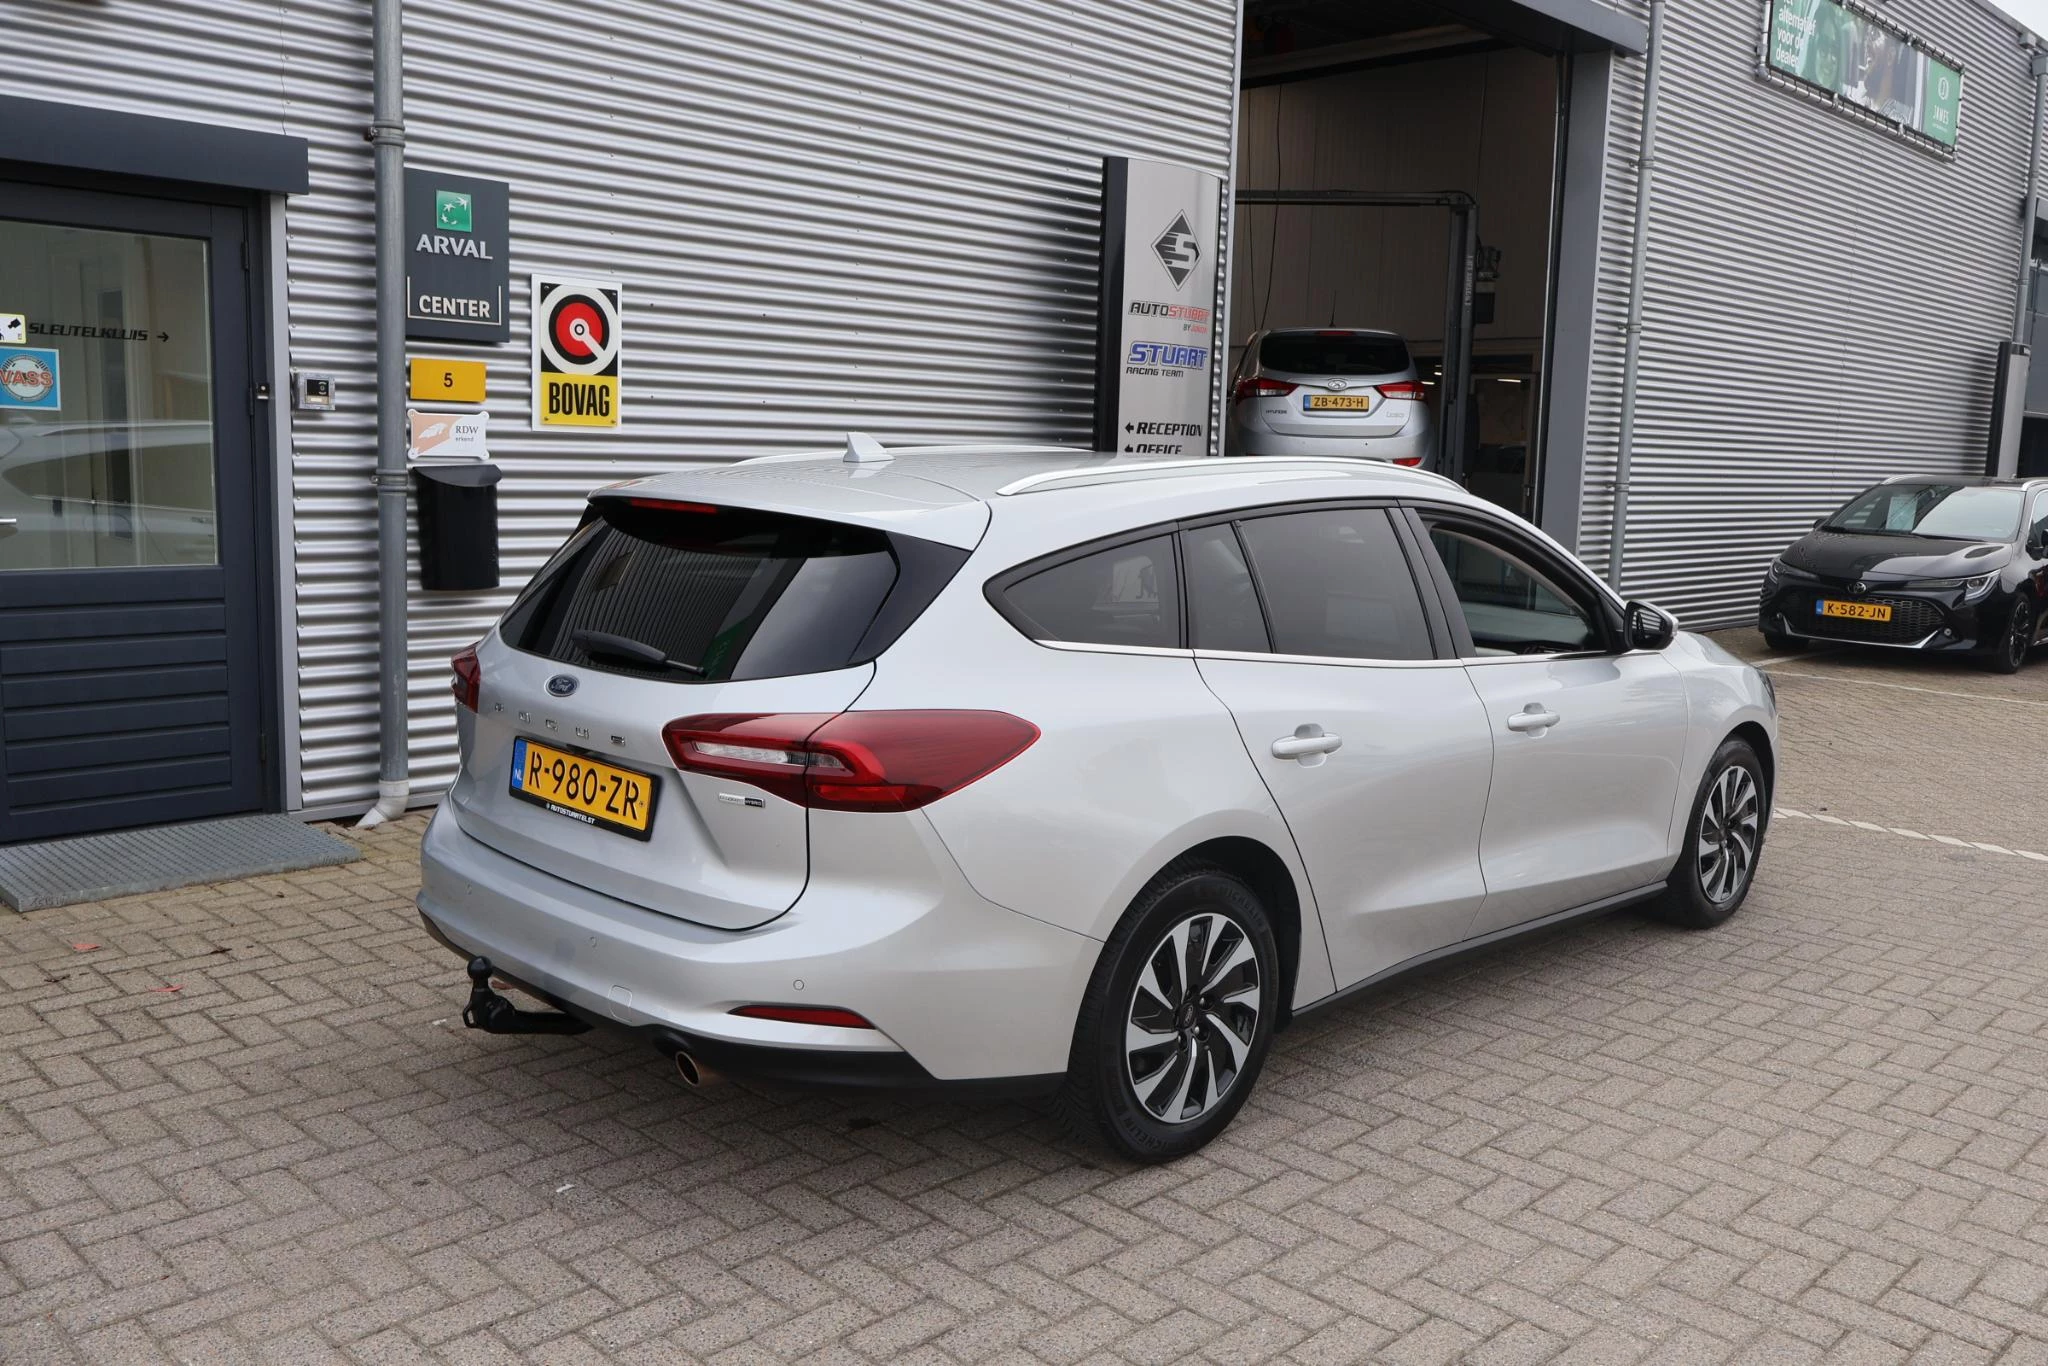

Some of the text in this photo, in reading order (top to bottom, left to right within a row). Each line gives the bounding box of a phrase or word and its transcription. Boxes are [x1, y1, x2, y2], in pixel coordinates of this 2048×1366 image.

[1778, 5, 1817, 37] alternatief
[1777, 27, 1794, 46] voor
[416, 233, 493, 260] ARVAL
[419, 295, 490, 318] CENTER
[28, 322, 149, 341] SLEUTELKLUIS
[1127, 341, 1208, 369] STUART
[0, 369, 53, 388] VASS
[443, 372, 453, 388] 5
[1126, 366, 1184, 378] RACING TEAM
[548, 382, 610, 417] BOVAG
[1313, 397, 1364, 408] ZB-473-H
[455, 425, 479, 435] RDW
[1136, 421, 1203, 437] RECEPTION
[1136, 443, 1182, 455] OFFICE
[1827, 603, 1887, 619] K-582-JN
[514, 767, 523, 782] NL
[528, 751, 640, 821] R-980-ZR
